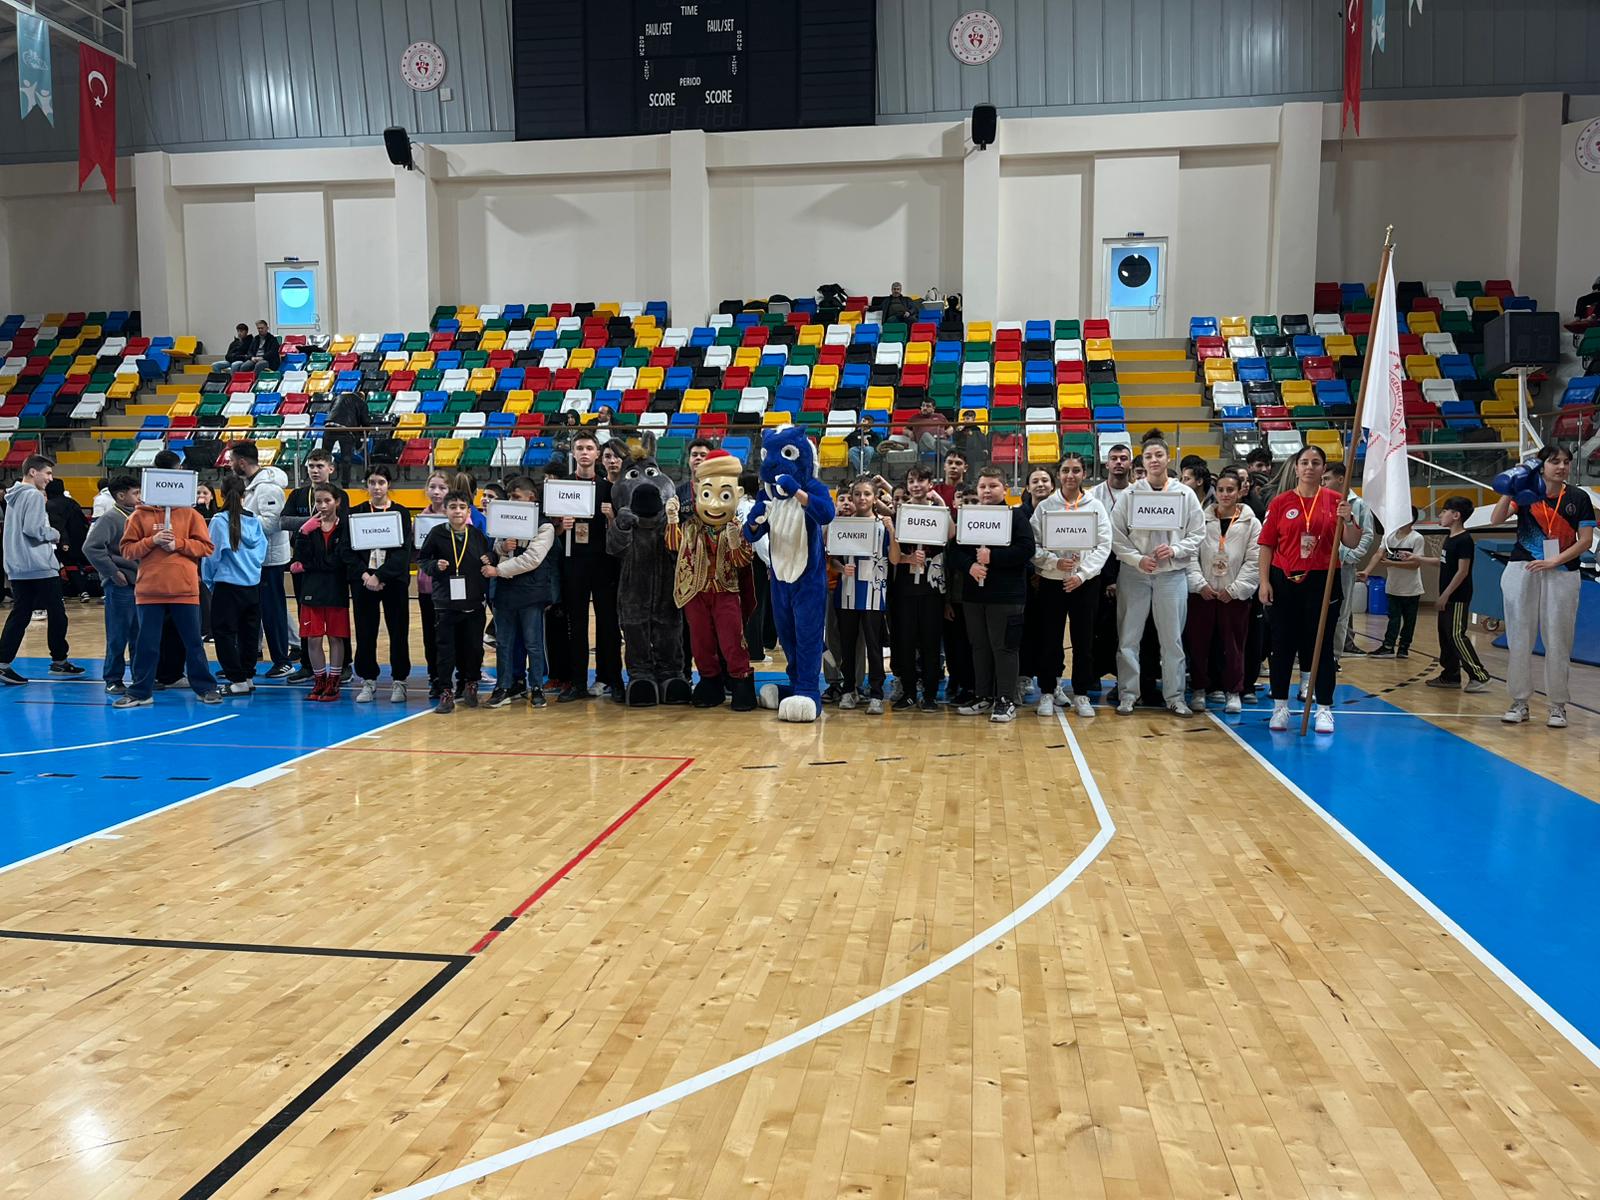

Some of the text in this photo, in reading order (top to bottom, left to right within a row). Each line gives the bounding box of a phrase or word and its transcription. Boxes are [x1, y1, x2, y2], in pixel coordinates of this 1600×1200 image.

[681, 5, 698, 15] TIME
[645, 22, 672, 36] FAUL/SET
[707, 19, 734, 32] FAUL/SET
[680, 77, 701, 86] PERIOD
[649, 92, 676, 106] SCORE
[705, 90, 732, 104] SCORE
[155, 481, 184, 489] KONYA
[558, 491, 581, 500] İZMİR
[1137, 506, 1175, 515] ANKARA
[907, 517, 938, 527] BURSA
[967, 521, 1001, 531] ÇORUM
[837, 531, 868, 540] ÇANKIRI
